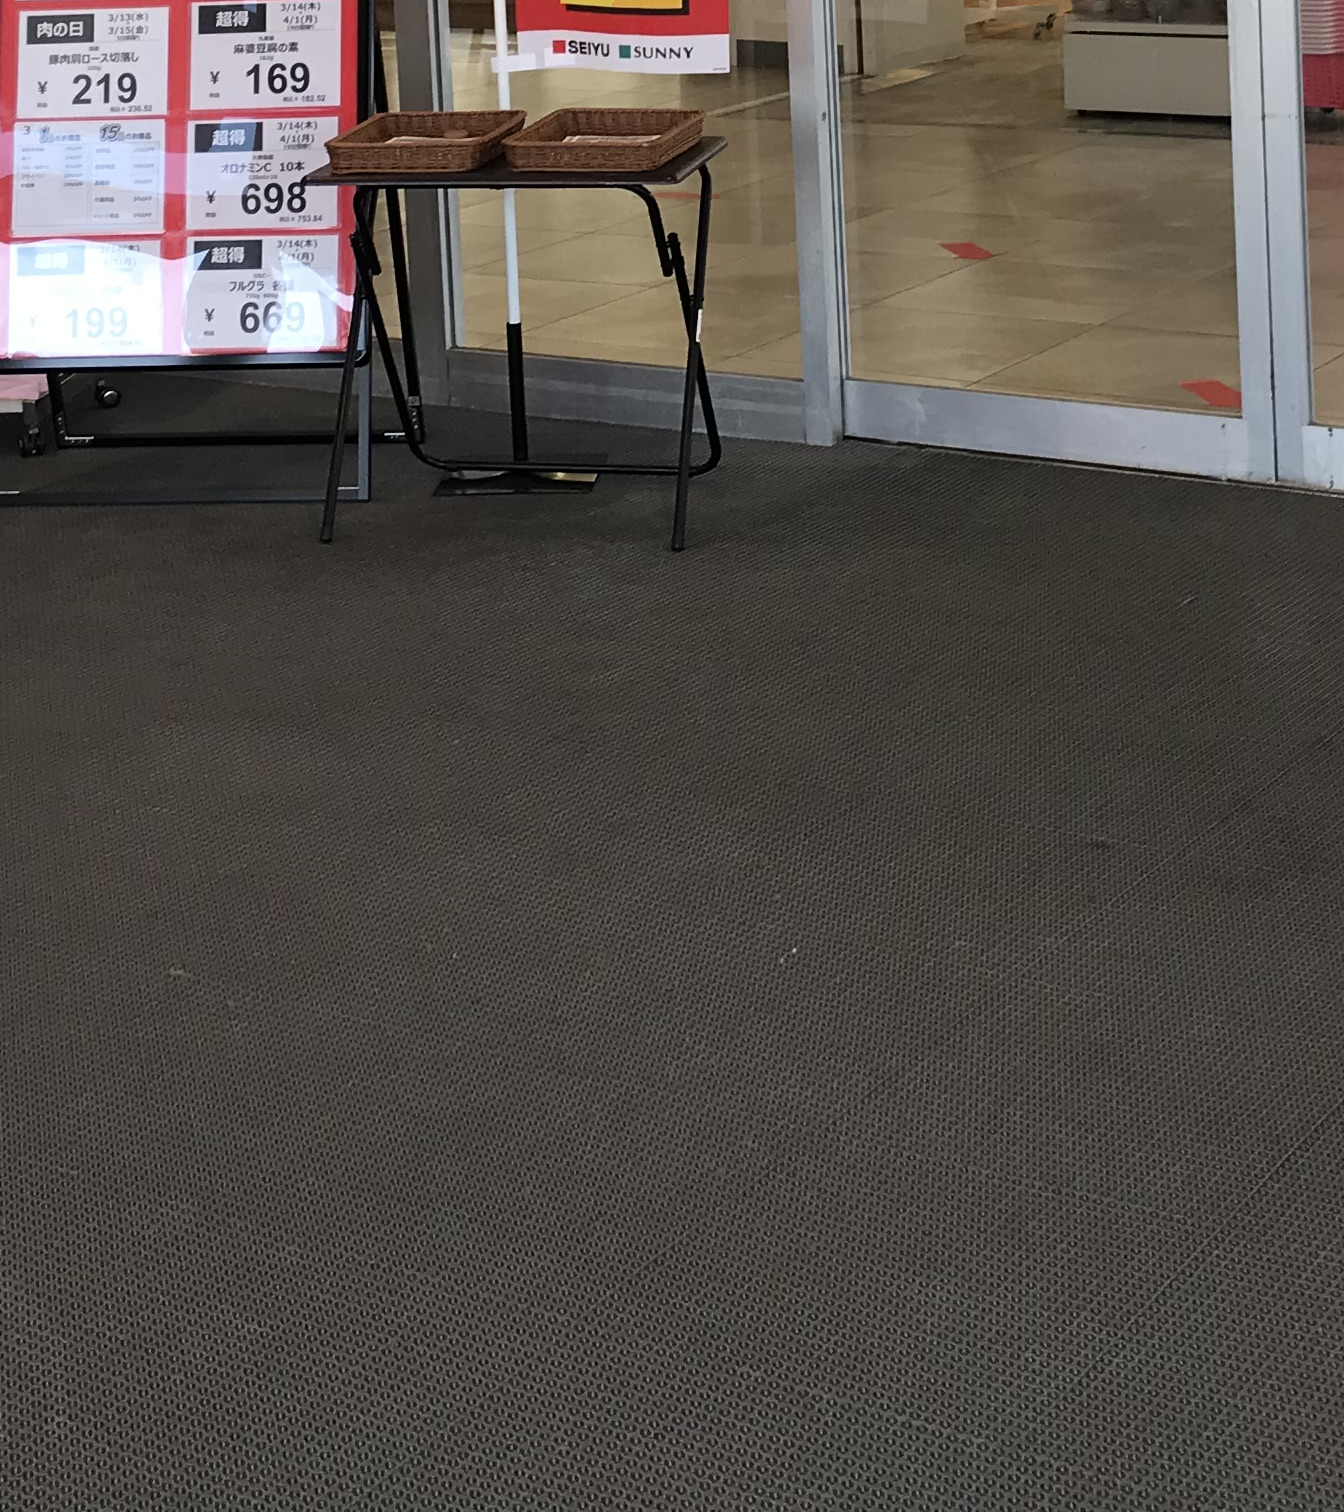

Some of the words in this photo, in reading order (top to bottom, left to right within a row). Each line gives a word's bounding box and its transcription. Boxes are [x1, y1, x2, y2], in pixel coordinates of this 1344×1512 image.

[280, 2, 321, 11] 3/14(木)
[215, 11, 249, 27] 超得
[283, 15, 318, 24] 4/1(月)
[37, 21, 84, 38] 肉の日
[233, 42, 299, 54] 麻婆豆腐の素
[568, 39, 610, 58] SEIYU
[633, 45, 694, 60] SUNNY
[246, 62, 310, 94] 169
[72, 72, 137, 104] 219
[277, 121, 318, 130] 3/14(木)
[212, 129, 246, 146] 超得
[279, 134, 315, 143] 4/1(月)
[220, 162, 272, 174] オロナミンC
[279, 161, 305, 172] 10本
[241, 182, 307, 214] 698
[276, 239, 318, 248] 3/14(木)
[211, 247, 245, 264] 超得
[229, 280, 265, 292] フルグラ
[65, 306, 128, 338] 199
[240, 301, 305, 333] 669
